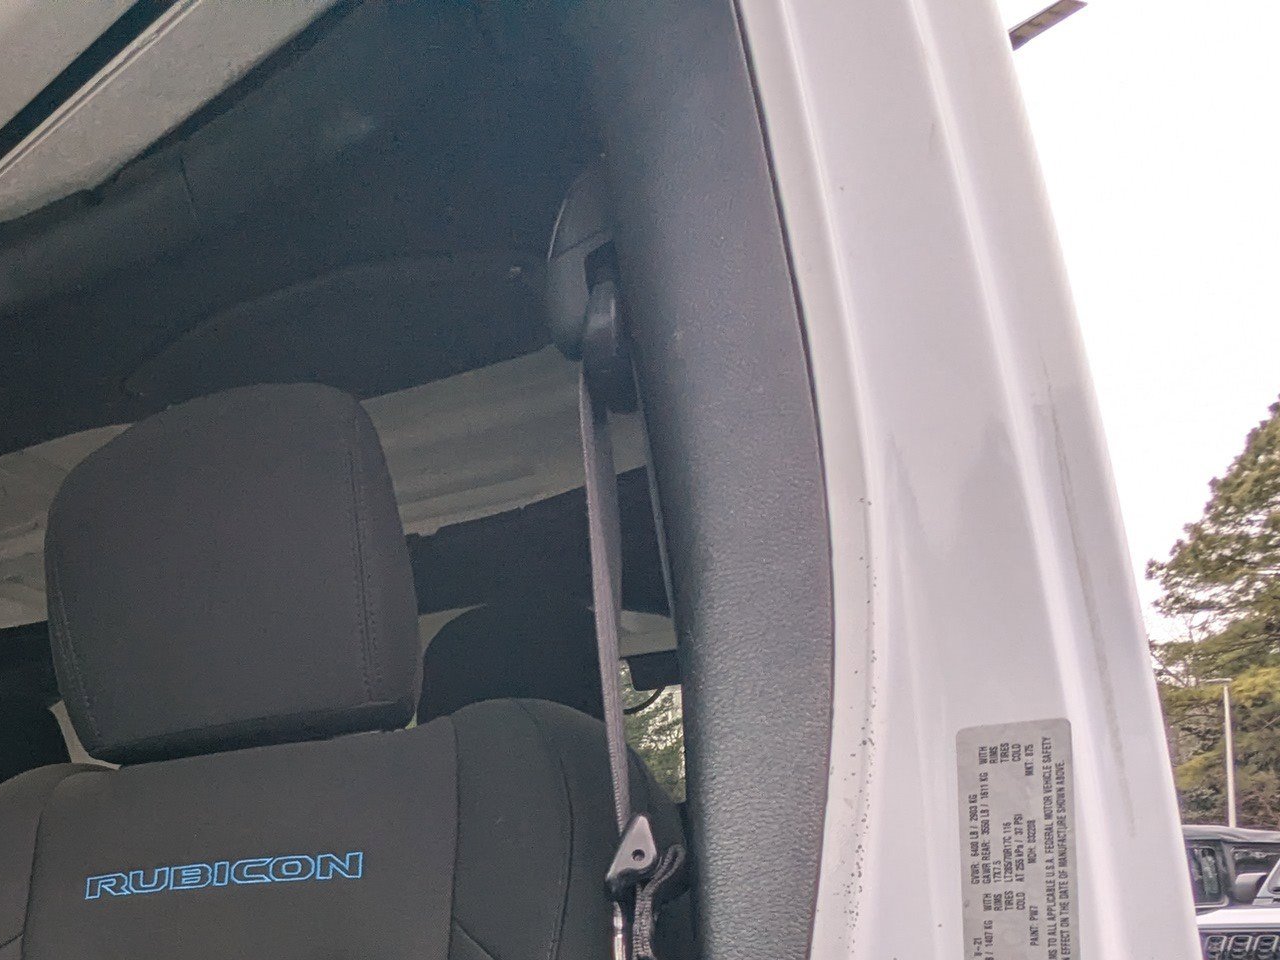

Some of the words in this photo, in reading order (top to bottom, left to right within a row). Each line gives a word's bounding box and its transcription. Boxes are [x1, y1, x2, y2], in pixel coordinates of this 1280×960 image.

[978, 745, 987, 764] WITH
[989, 746, 998, 763] RIMS
[999, 742, 1009, 762] TIRES
[1011, 743, 1021, 761] COLD
[1041, 736, 1051, 762] SAFETY
[979, 772, 988, 781] KG
[1042, 765, 1052, 793] VEHICLE
[968, 794, 977, 803] KG
[1043, 795, 1053, 819] MOTOR
[1055, 786, 1066, 812] SHOWN
[980, 808, 989, 817] LB
[1013, 813, 1022, 825] PSI
[969, 830, 978, 839] LB
[1014, 827, 1022, 835] 37
[1043, 822, 1054, 853] FEDERAL
[1056, 815, 1068, 867] MANUFACTURE
[84, 851, 364, 900] RUBICON
[981, 862, 991, 884] GAWR
[1015, 873, 1024, 882] AT
[1058, 870, 1068, 878] OF
[1058, 880, 1068, 898] DATE
[982, 893, 992, 911] WITH
[993, 893, 1002, 911] RIMS
[1004, 890, 1013, 910] TIRES
[1015, 892, 1025, 910] COLD
[1046, 879, 1056, 920] APPLICABLE
[1059, 901, 1069, 914] THE
[983, 920, 992, 929] KG
[1047, 923, 1056, 935] ALL
[1059, 917, 1069, 926] ON
[1047, 937, 1056, 946] TO
[1060, 929, 1070, 954] EFFECT
